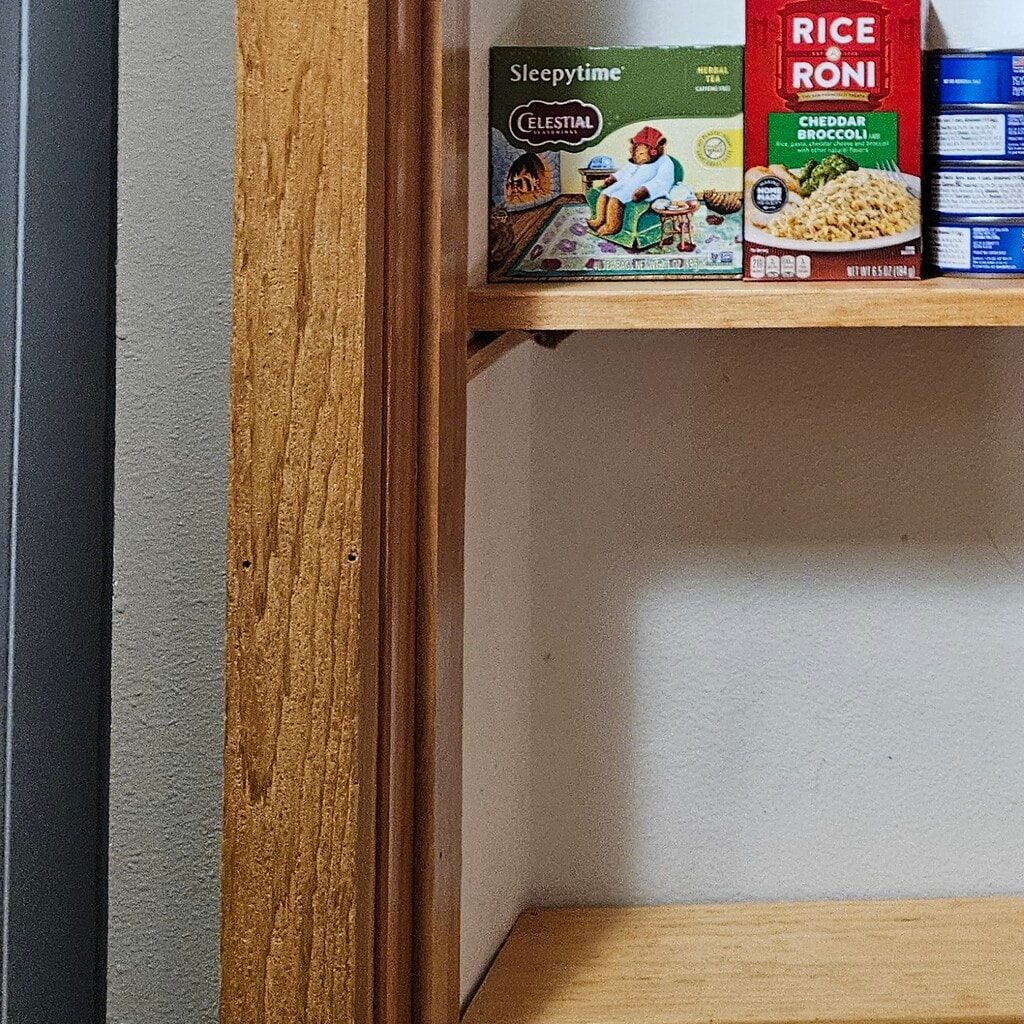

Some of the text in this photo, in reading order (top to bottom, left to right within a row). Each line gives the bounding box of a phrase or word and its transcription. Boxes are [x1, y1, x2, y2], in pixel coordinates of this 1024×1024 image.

[793, 17, 875, 44] RICE
[510, 63, 621, 86] Sleepytime
[697, 66, 729, 74] HERBAL
[793, 61, 875, 89] RONI
[706, 75, 721, 83] TEA
[517, 112, 594, 133] CELESTIAL
[799, 116, 866, 127] CHEDDAR
[797, 129, 867, 140] BROCCOLI
[847, 266, 860, 277] NET
[861, 266, 871, 277] WT
[883, 266, 893, 277] OZ
